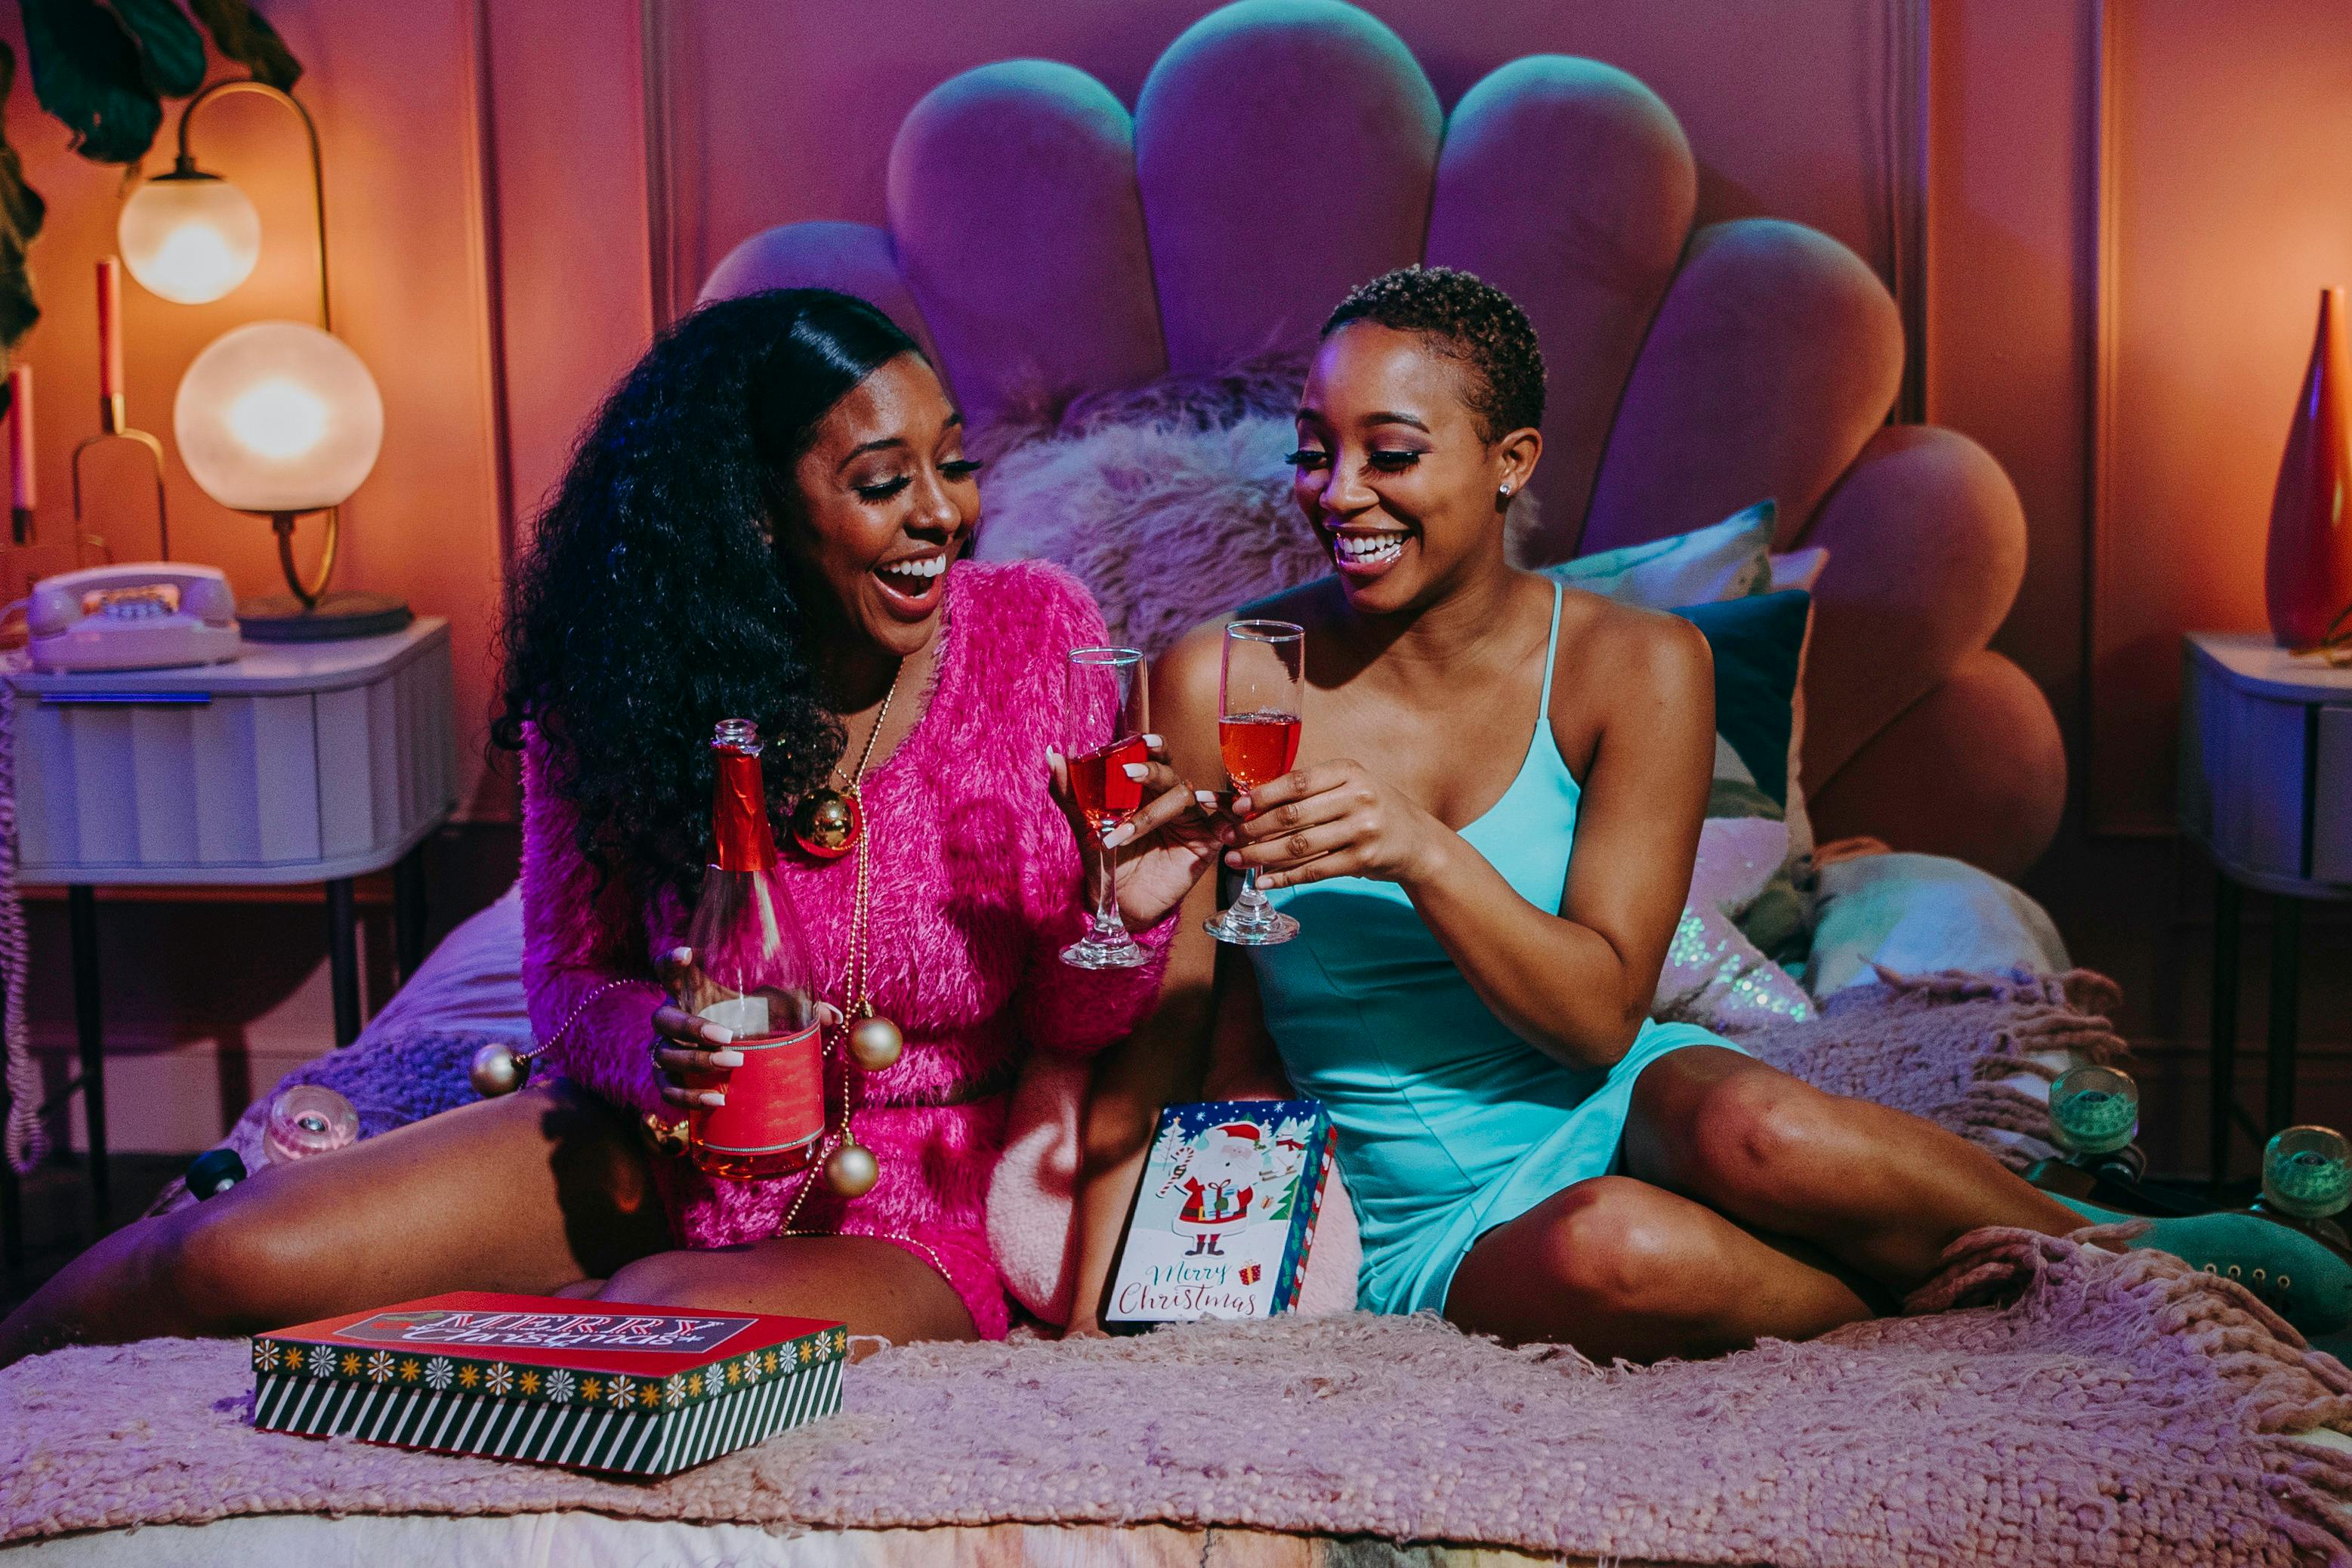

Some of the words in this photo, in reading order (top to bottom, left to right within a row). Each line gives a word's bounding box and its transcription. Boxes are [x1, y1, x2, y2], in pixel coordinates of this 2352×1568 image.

[1145, 1261, 1232, 1286] Merry
[1119, 1282, 1257, 1315] Christmas
[424, 1313, 725, 1335] MERRY
[401, 1328, 678, 1345] Christmas
